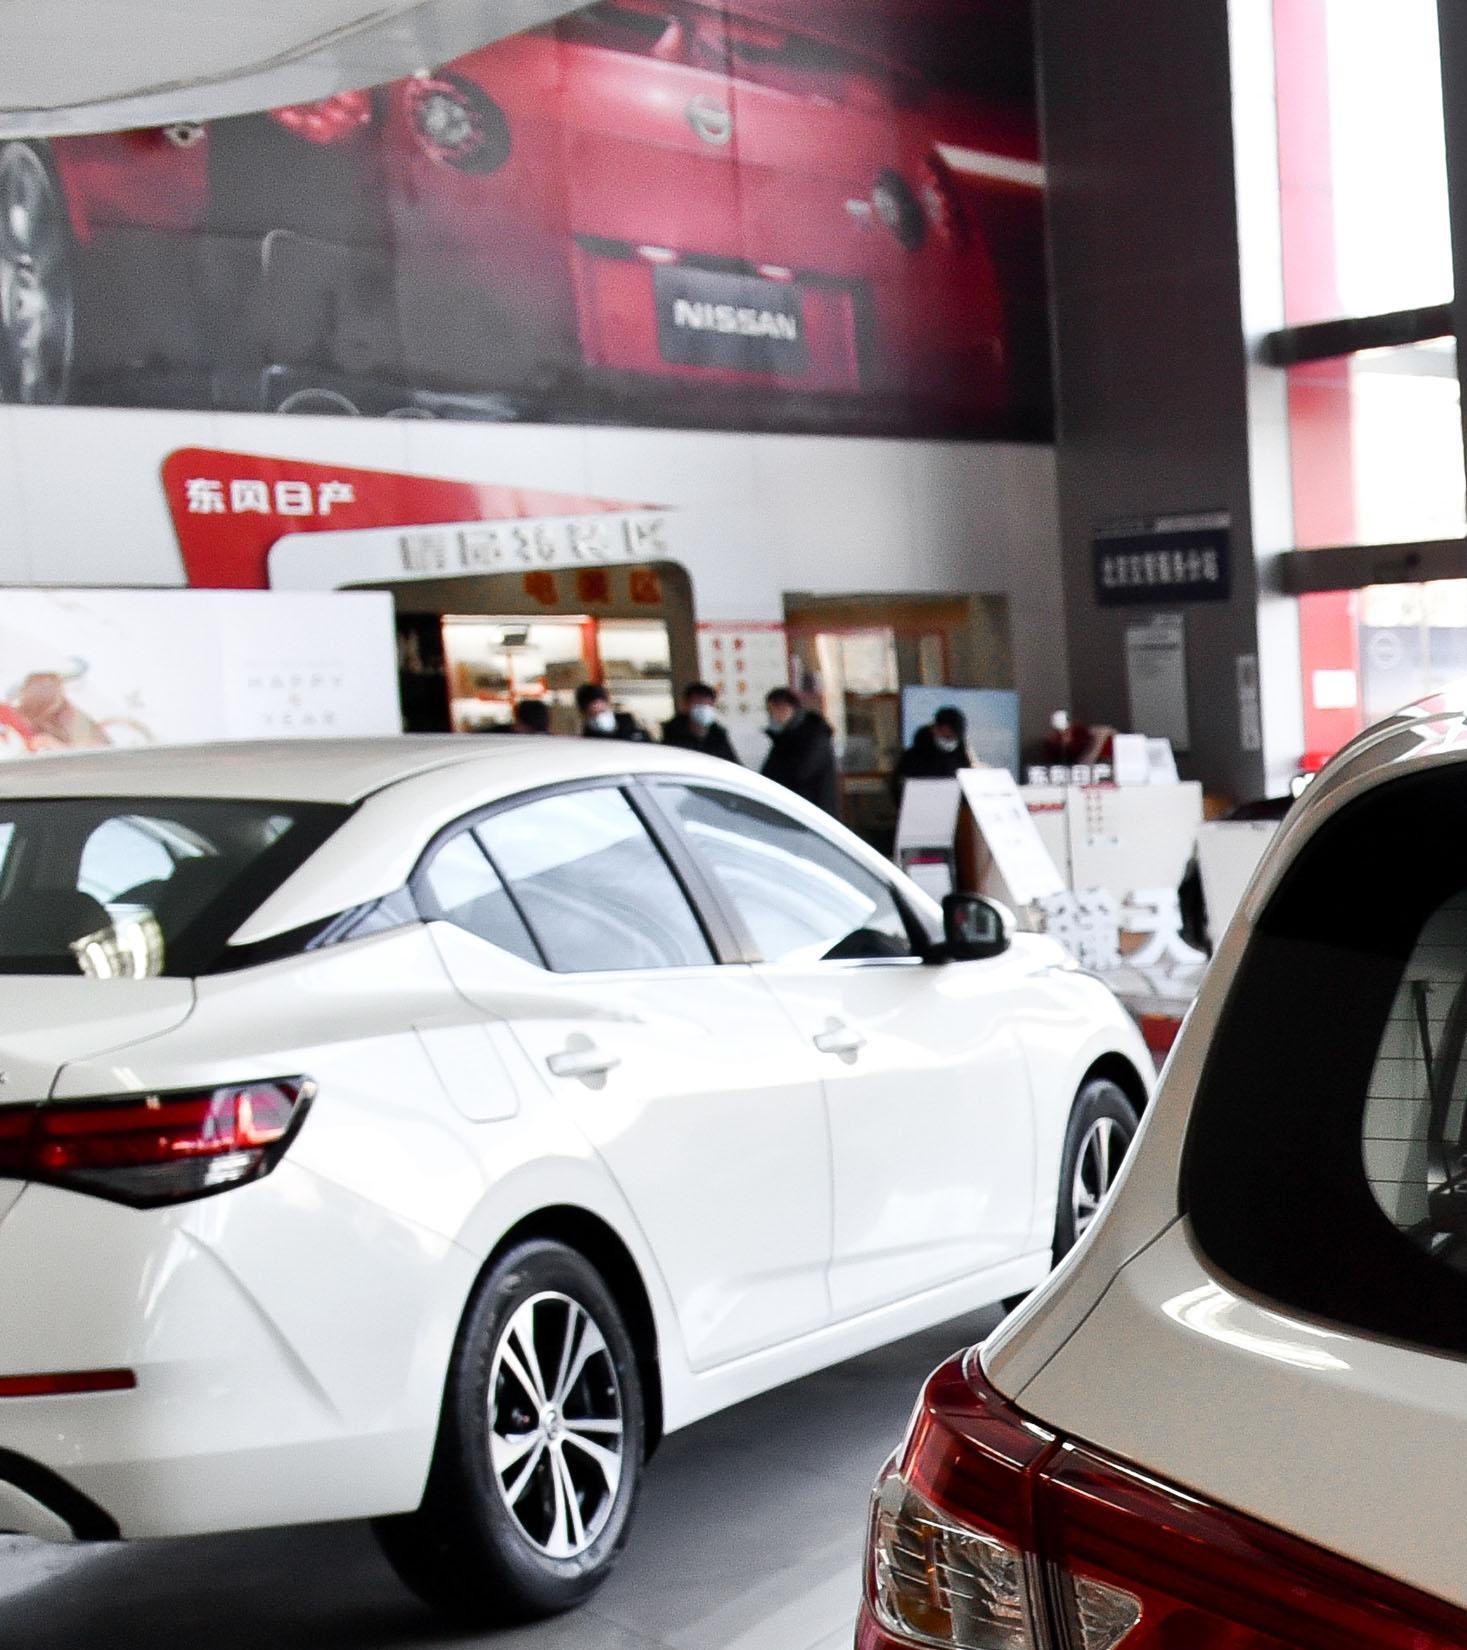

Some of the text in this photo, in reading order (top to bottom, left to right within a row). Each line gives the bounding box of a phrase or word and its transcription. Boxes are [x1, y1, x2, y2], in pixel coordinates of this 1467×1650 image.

[673, 299, 796, 340] NISSAN
[185, 477, 356, 516] 东风日产
